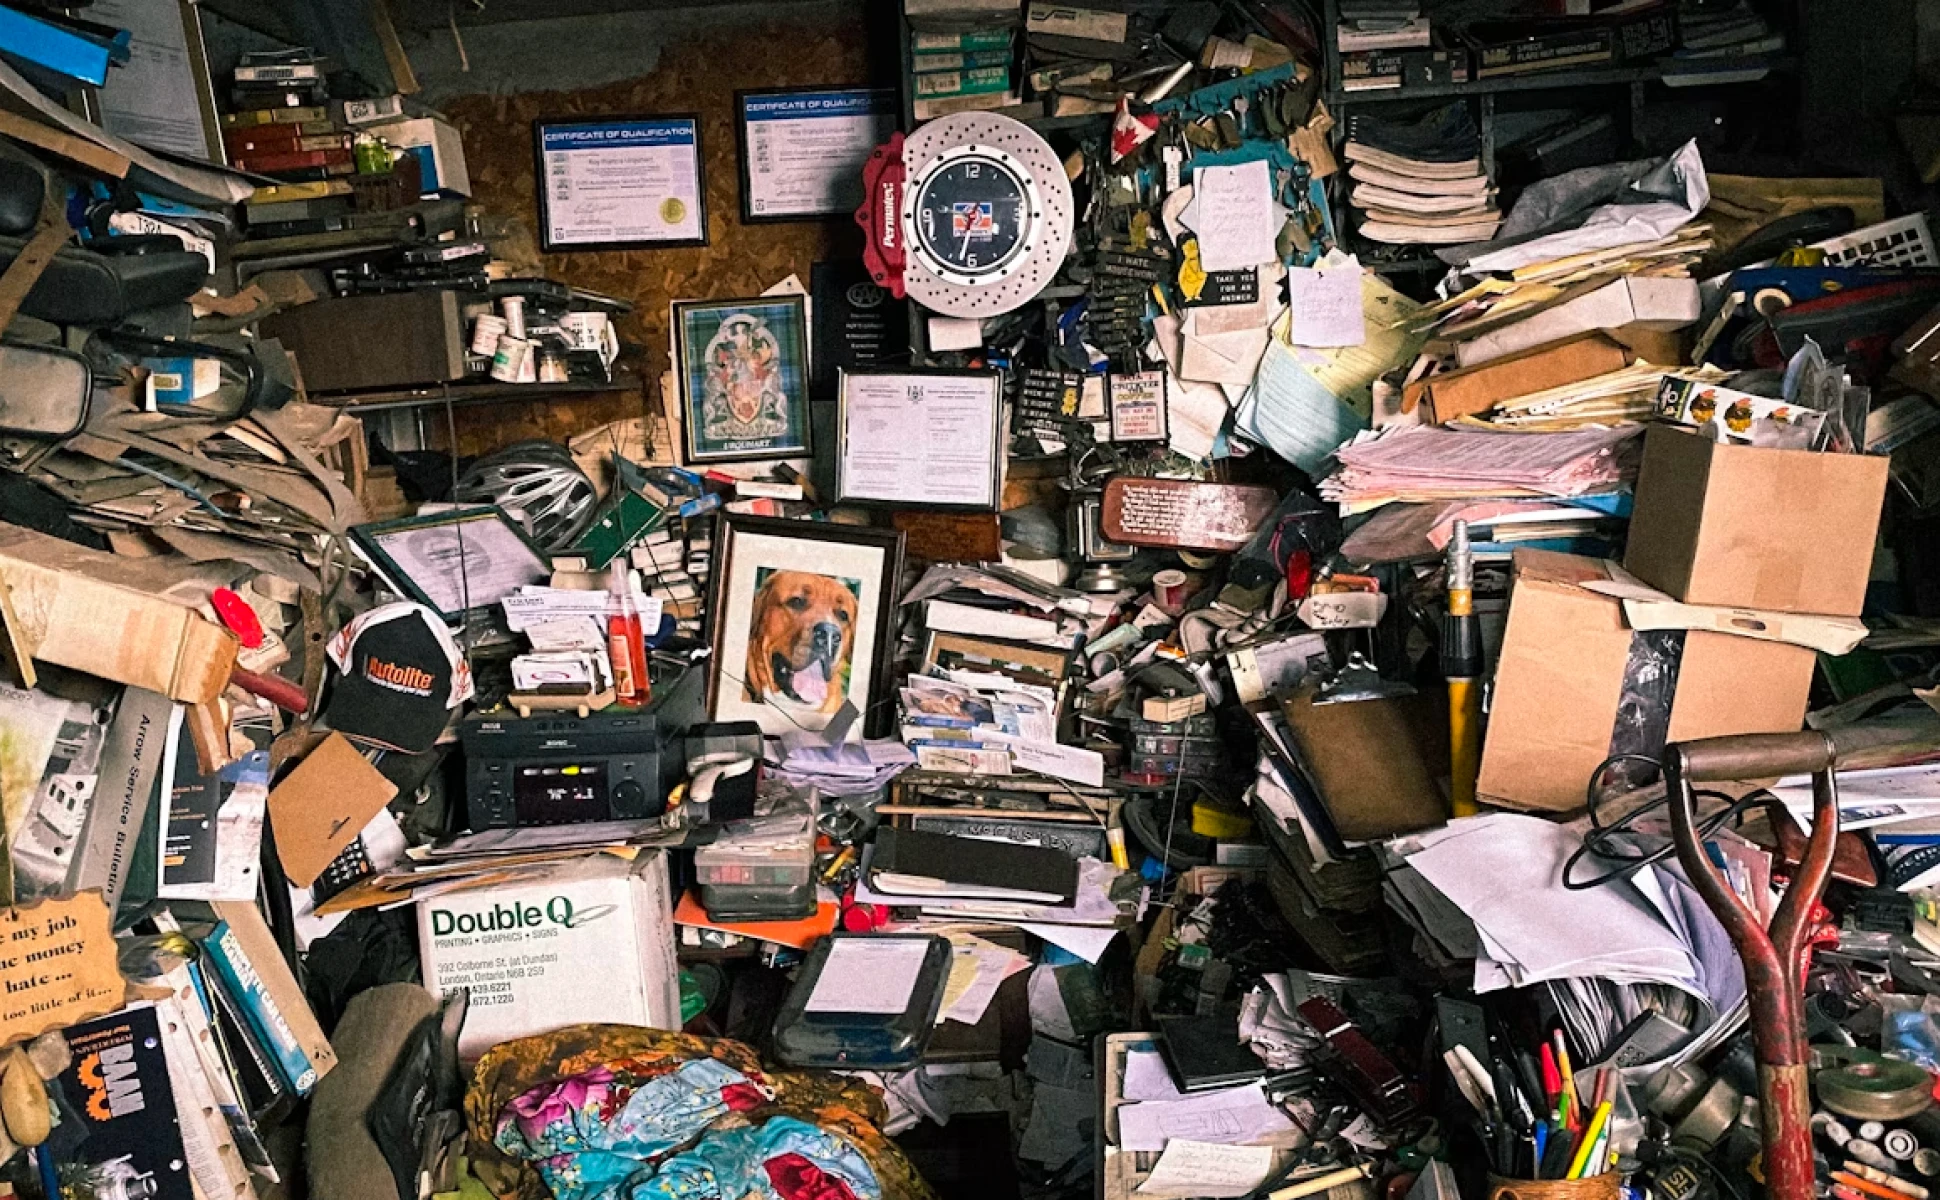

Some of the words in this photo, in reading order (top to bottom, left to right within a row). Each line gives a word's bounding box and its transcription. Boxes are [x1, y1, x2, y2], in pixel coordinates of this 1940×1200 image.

[746, 101, 805, 111] CERTIFICATE
[808, 100, 820, 109] OF
[545, 130, 604, 141] CERTIFICATE
[606, 130, 620, 139] OF
[621, 127, 692, 138] QUALIFICATION
[964, 164, 980, 178] 12
[883, 182, 895, 248] Permatex
[923, 209, 932, 224] 9
[967, 254, 977, 268] 6
[1125, 257, 1149, 267] HATE
[1215, 275, 1234, 283] TAKE
[1117, 392, 1155, 401] COFFEE
[369, 656, 434, 690] Autolite
[133, 714, 151, 761] Arrow
[121, 766, 140, 825] Service
[107, 831, 126, 894] Bulletin
[431, 901, 543, 936] Double
[547, 896, 575, 928] Q
[12, 926, 38, 941] my
[46, 915, 77, 937] job
[435, 937, 473, 948] PRINTING
[481, 932, 522, 944] GRAPHICS
[532, 928, 558, 939] SIGNS
[26, 940, 85, 963] money
[438, 962, 455, 973] 392
[456, 959, 494, 972] Colborne
[510, 955, 521, 967] (at
[523, 953, 558, 966] Dundas)
[5, 976, 49, 994] hate
[440, 974, 473, 986] London,
[475, 970, 505, 982] Ontario
[507, 968, 525, 979] N6B
[3, 1009, 26, 1021] too
[30, 999, 62, 1014] little
[68, 991, 82, 1003] of
